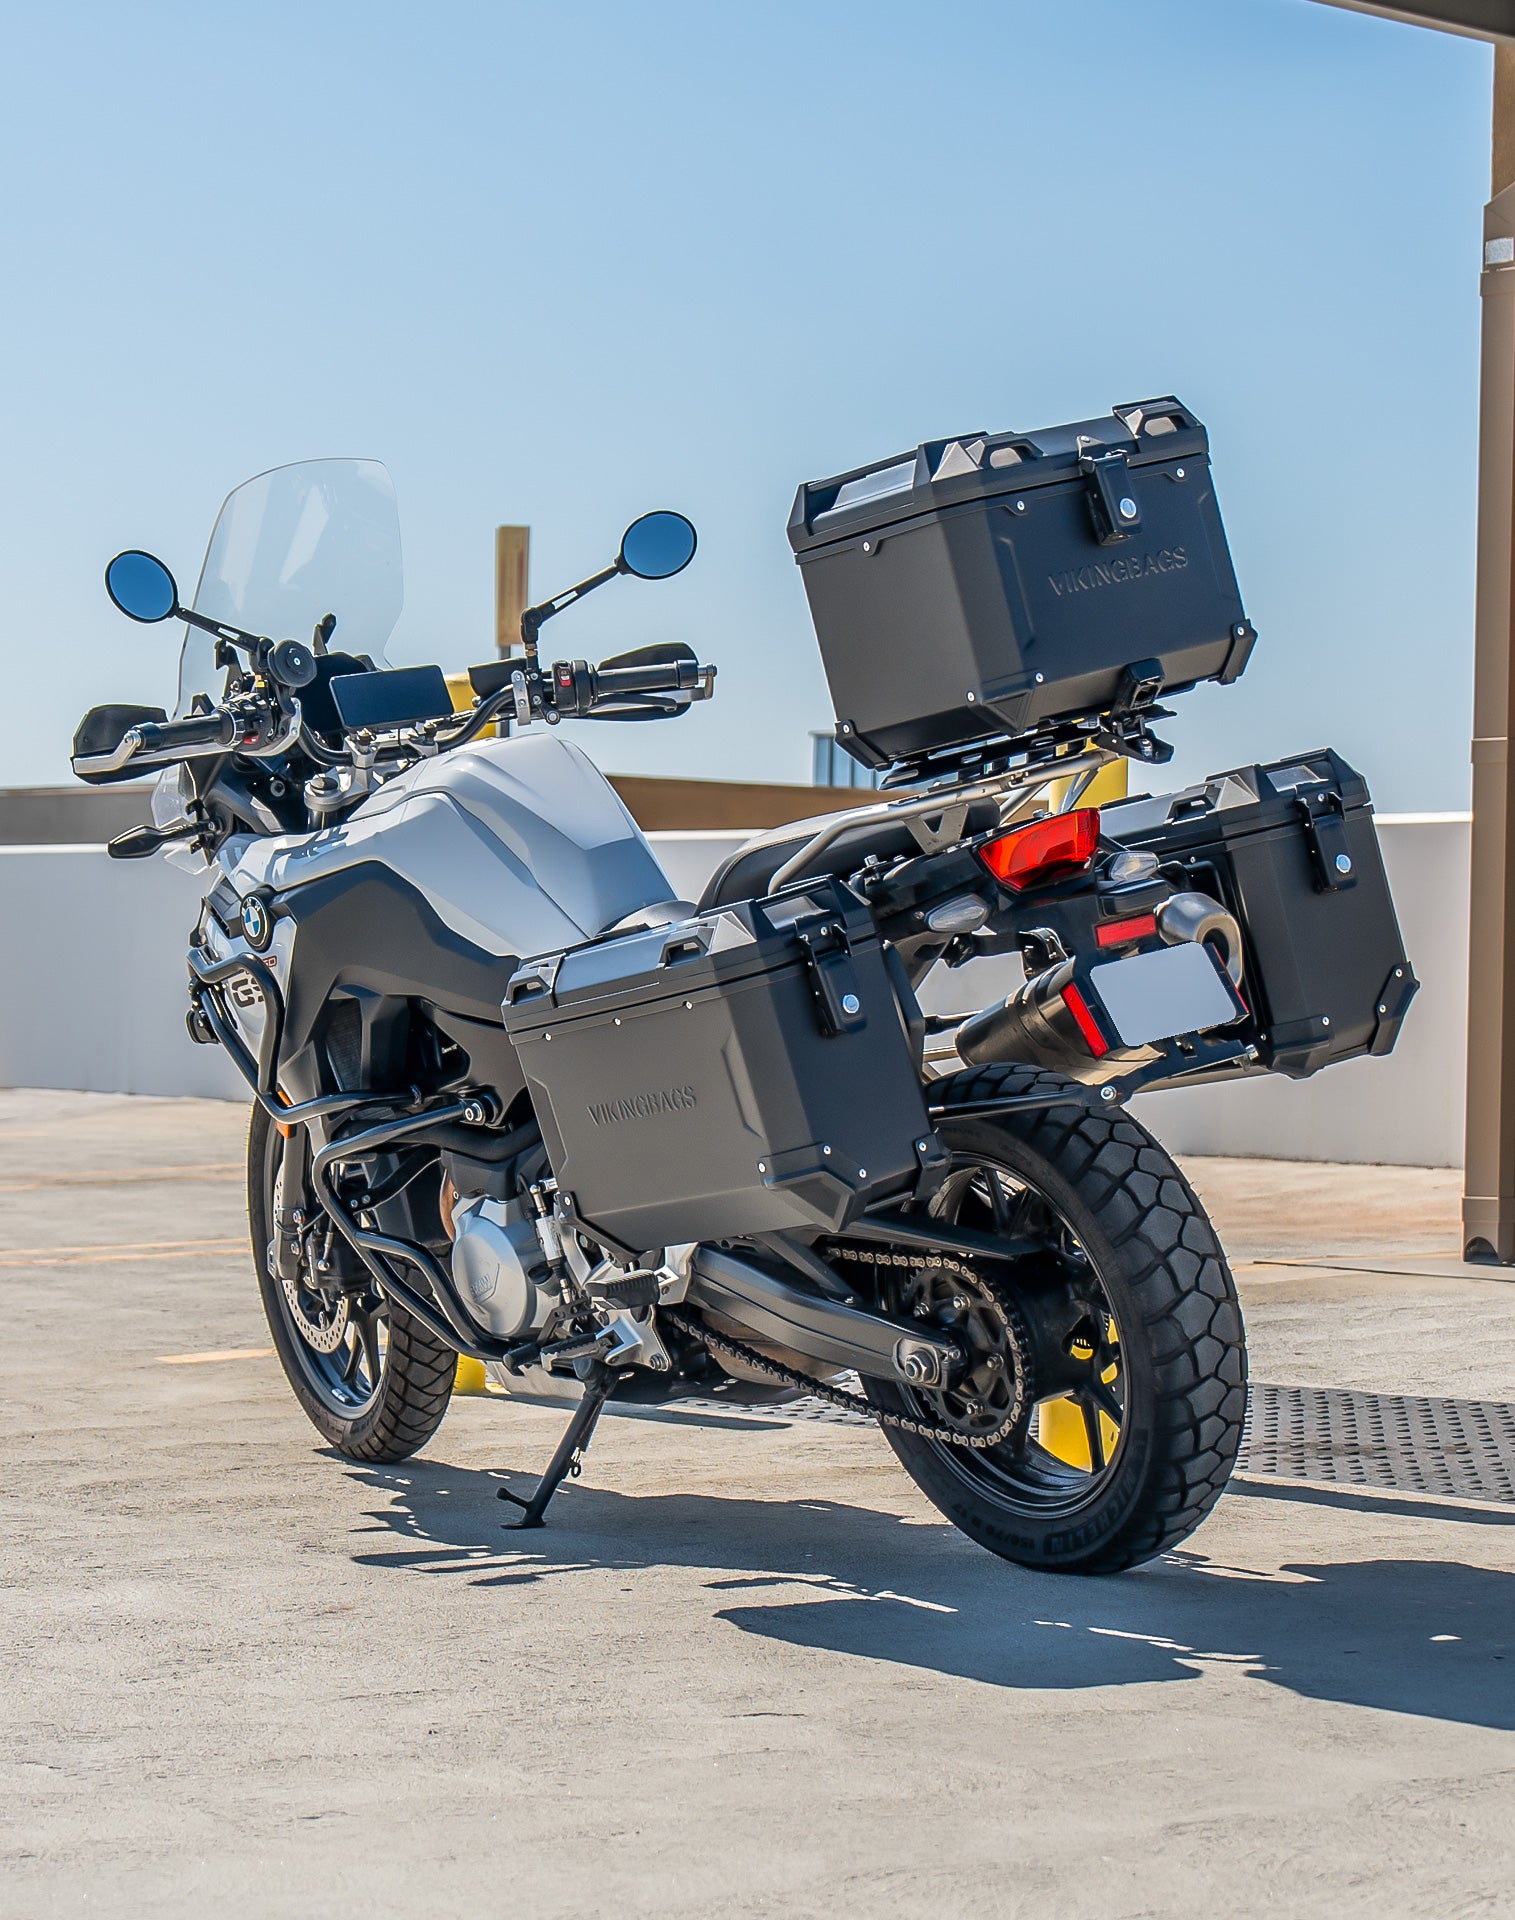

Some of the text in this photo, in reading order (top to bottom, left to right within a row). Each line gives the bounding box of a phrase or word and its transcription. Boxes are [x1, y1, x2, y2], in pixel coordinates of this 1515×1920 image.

[1048, 546, 1188, 596] VIKINGBAGS
[586, 1085, 696, 1126] VIKINGBAGS
[1051, 1467, 1138, 1553] MICHELIN
